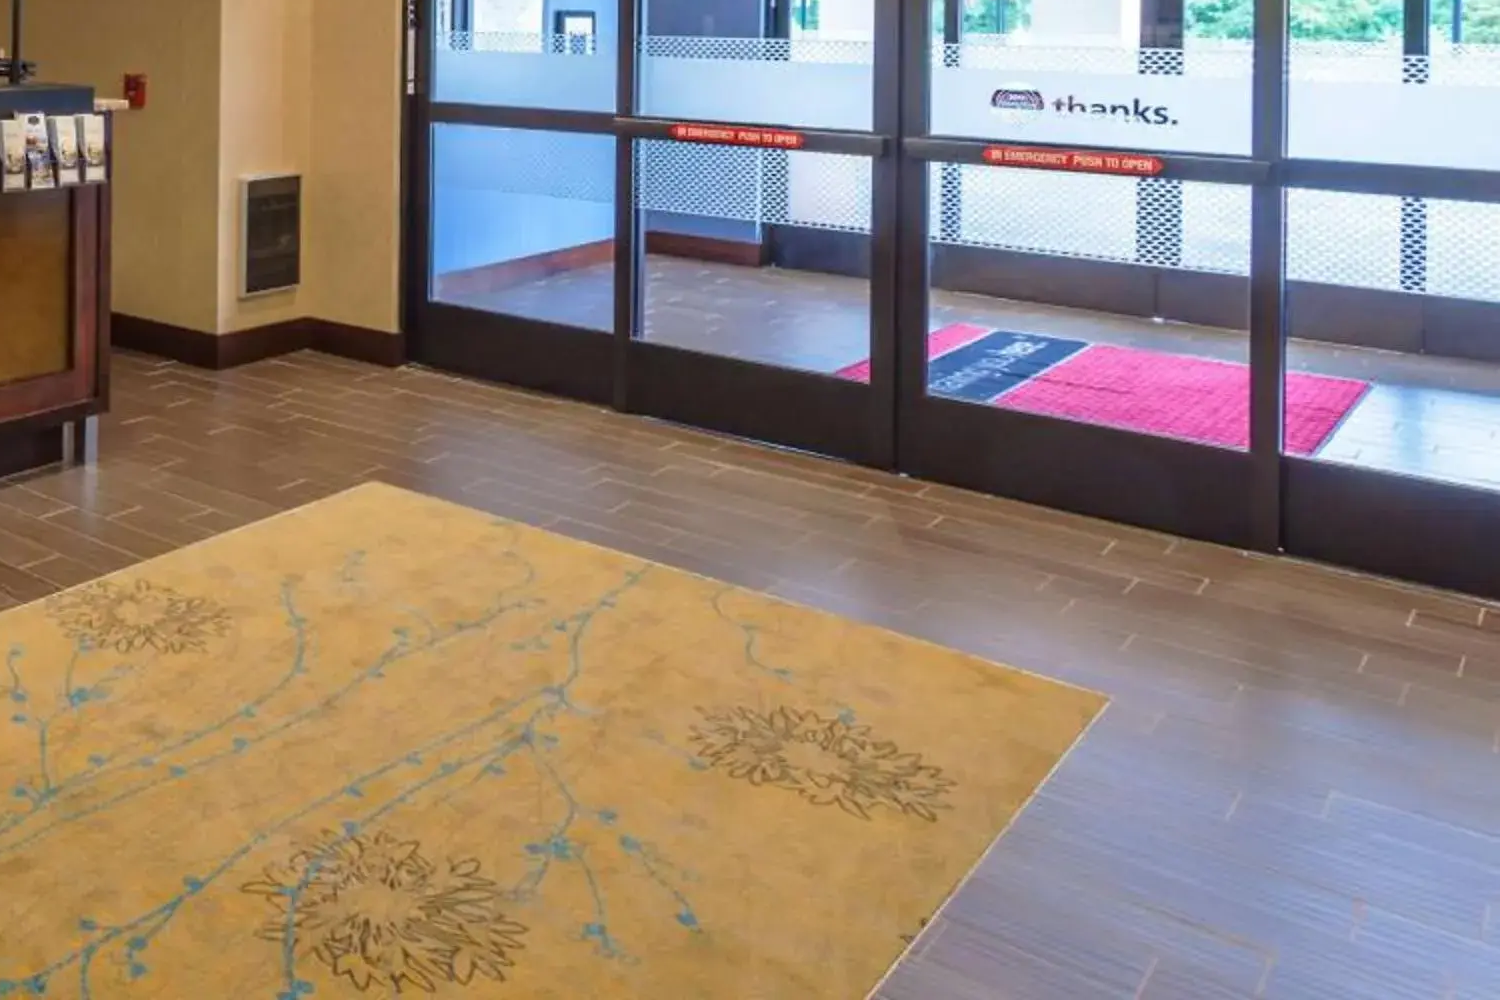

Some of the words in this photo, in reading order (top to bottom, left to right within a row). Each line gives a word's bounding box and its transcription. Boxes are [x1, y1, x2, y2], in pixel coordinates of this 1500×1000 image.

[1051, 95, 1179, 126] thanks.
[991, 149, 1002, 161] IN
[1004, 150, 1068, 165] EMERGENCY
[1073, 154, 1103, 168] PUSH
[1105, 156, 1119, 169] TO
[1121, 158, 1154, 172] OPEN
